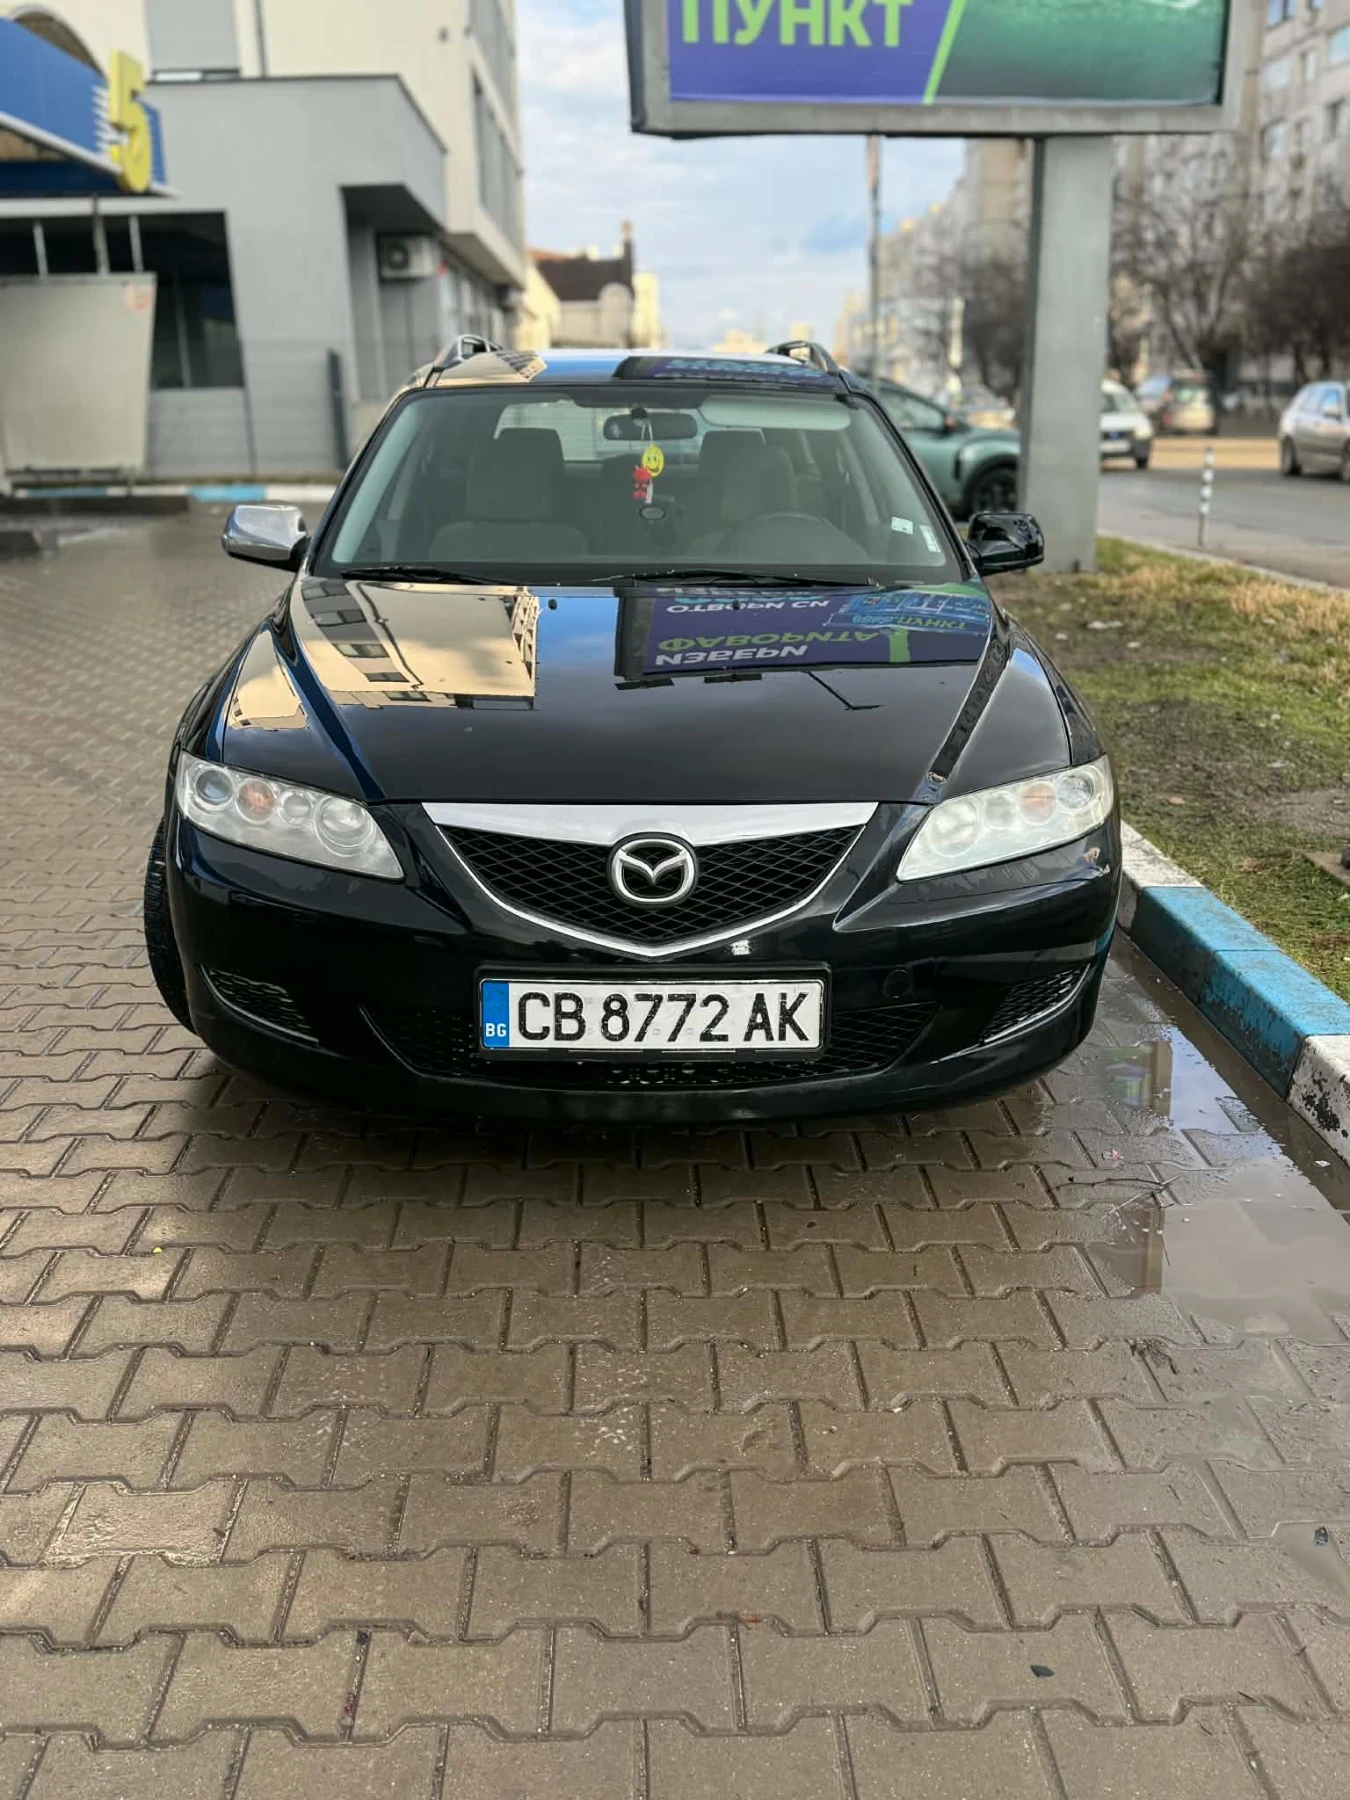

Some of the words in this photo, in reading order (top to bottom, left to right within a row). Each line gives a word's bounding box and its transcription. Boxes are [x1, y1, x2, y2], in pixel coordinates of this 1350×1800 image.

[682, 0, 914, 47] ПУНКТ
[485, 1022, 507, 1037] BG
[600, 992, 730, 1042] 8772
[743, 992, 809, 1042] AK
